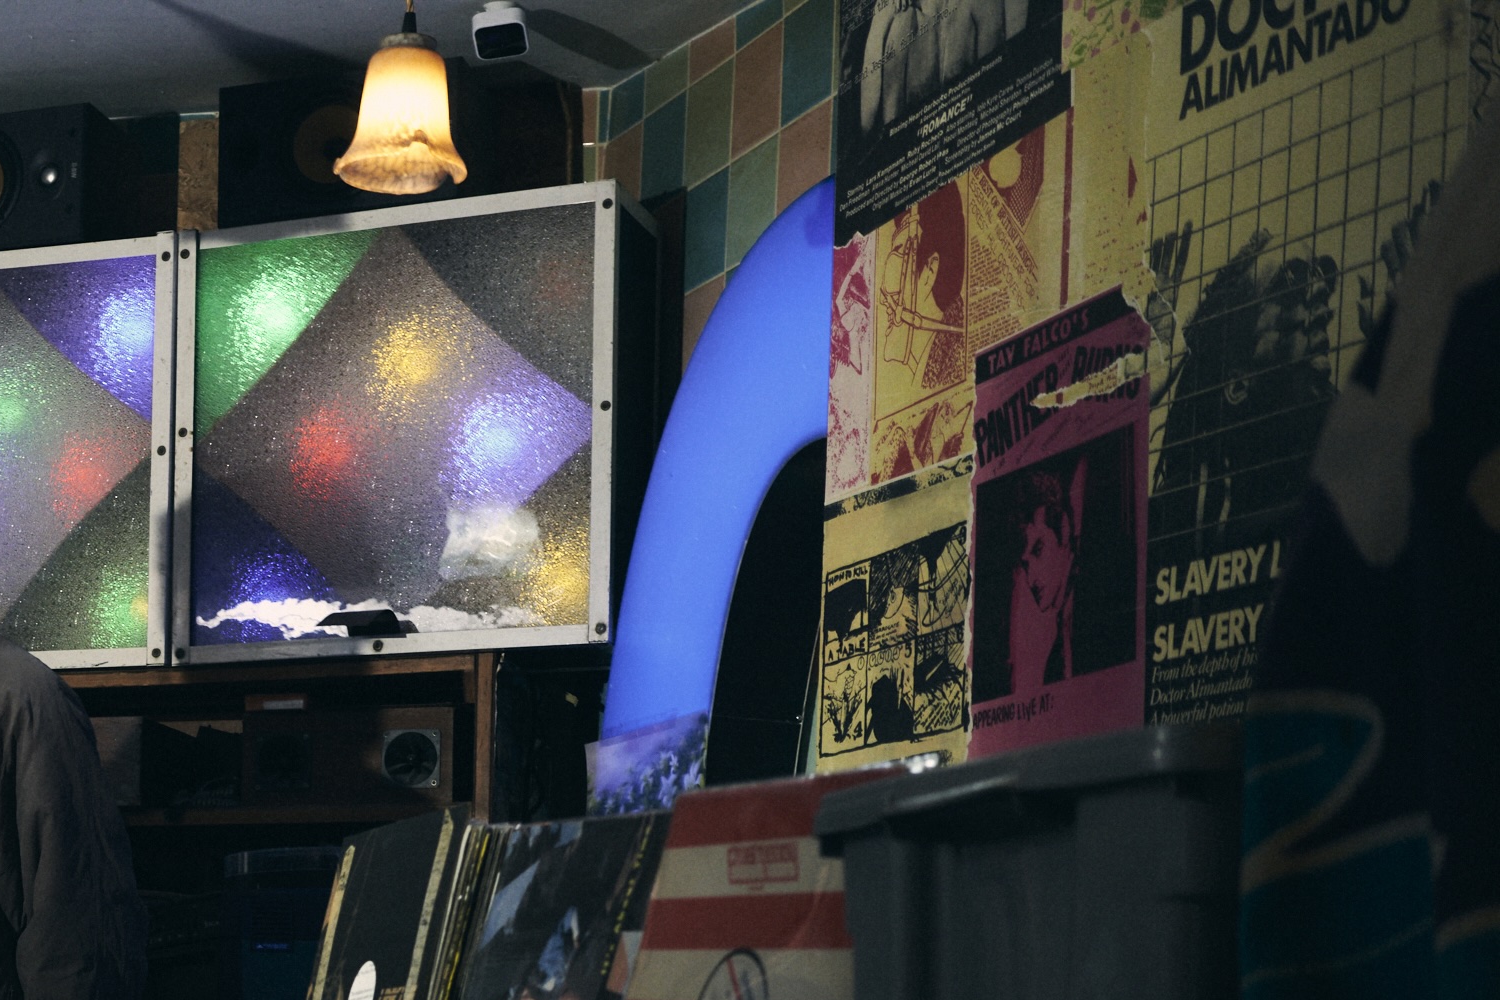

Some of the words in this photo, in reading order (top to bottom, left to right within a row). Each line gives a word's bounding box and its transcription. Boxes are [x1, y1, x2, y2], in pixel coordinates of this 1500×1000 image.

[1179, 0, 1409, 121] ALIMANTADO
[1180, 0, 1317, 75] DO
[947, 70, 979, 97] Productions
[980, 56, 1002, 74] Presents
[977, 127, 995, 144] James
[979, 179, 994, 194] BEST
[998, 206, 1019, 238] BRITISH
[988, 344, 1016, 375] TAY
[1023, 308, 1090, 358] FALCO'S
[1154, 544, 1267, 606] SLAVERY
[1152, 603, 1265, 663] SLAVERY
[1150, 683, 1185, 706] Doctor
[1185, 671, 1253, 700] Alimantado
[1151, 662, 1180, 684] From
[1181, 656, 1197, 681] the
[1198, 650, 1230, 679] depth
[1230, 644, 1243, 673] of
[973, 702, 1015, 730] APPEARING
[1016, 696, 1036, 722] LIVE
[1207, 693, 1245, 720] potion
